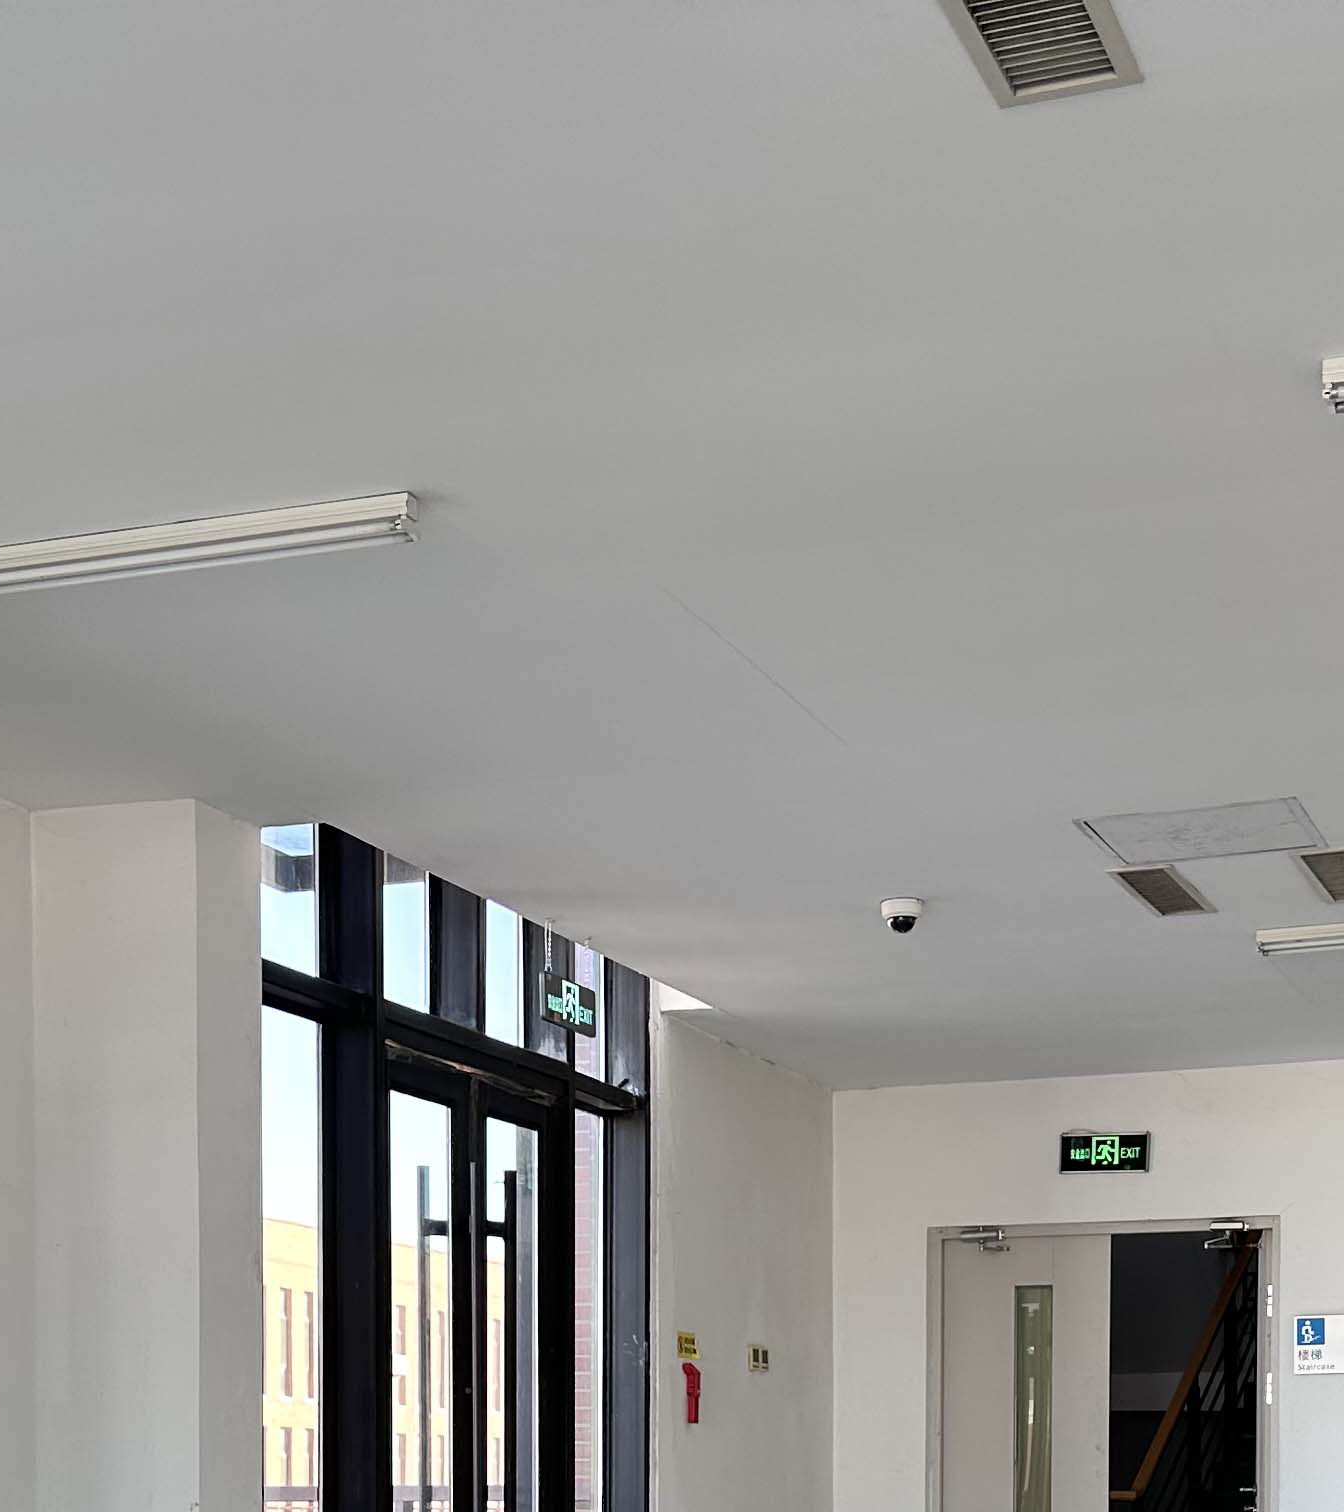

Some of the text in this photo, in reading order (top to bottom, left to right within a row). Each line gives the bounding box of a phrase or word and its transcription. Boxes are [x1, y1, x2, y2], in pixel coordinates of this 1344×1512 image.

[1120, 1146, 1141, 1159] EXIT
[1298, 1348, 1323, 1361] 楼梯
[1297, 1363, 1335, 1371] Staircase
